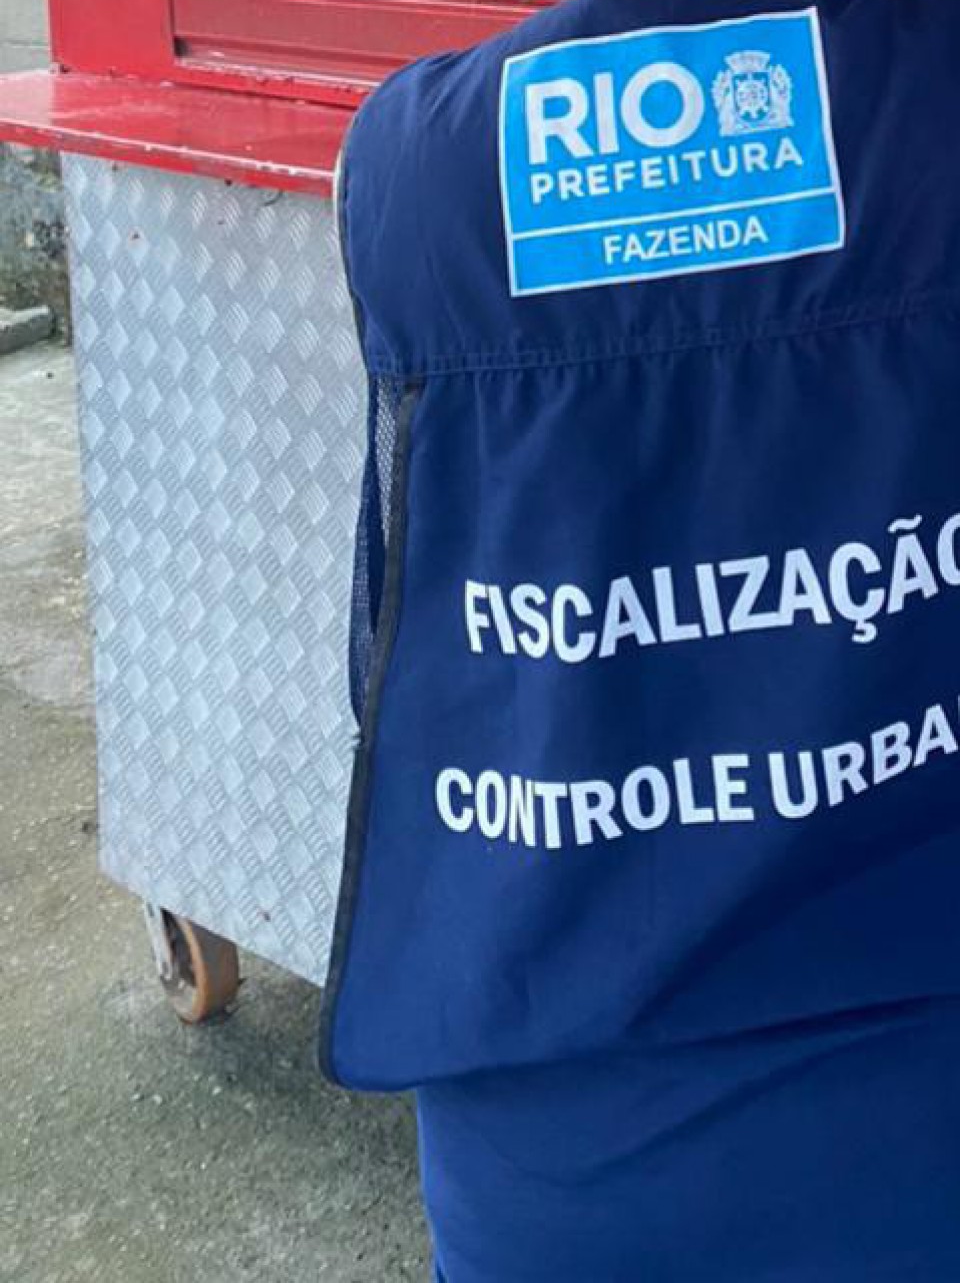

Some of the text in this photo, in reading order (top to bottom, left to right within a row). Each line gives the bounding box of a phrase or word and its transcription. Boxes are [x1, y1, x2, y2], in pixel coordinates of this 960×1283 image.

[525, 61, 705, 165] RIO
[530, 137, 804, 205] PREFEITURA
[603, 215, 769, 265] FAZENDA
[435, 753, 755, 849] CONTROLE
